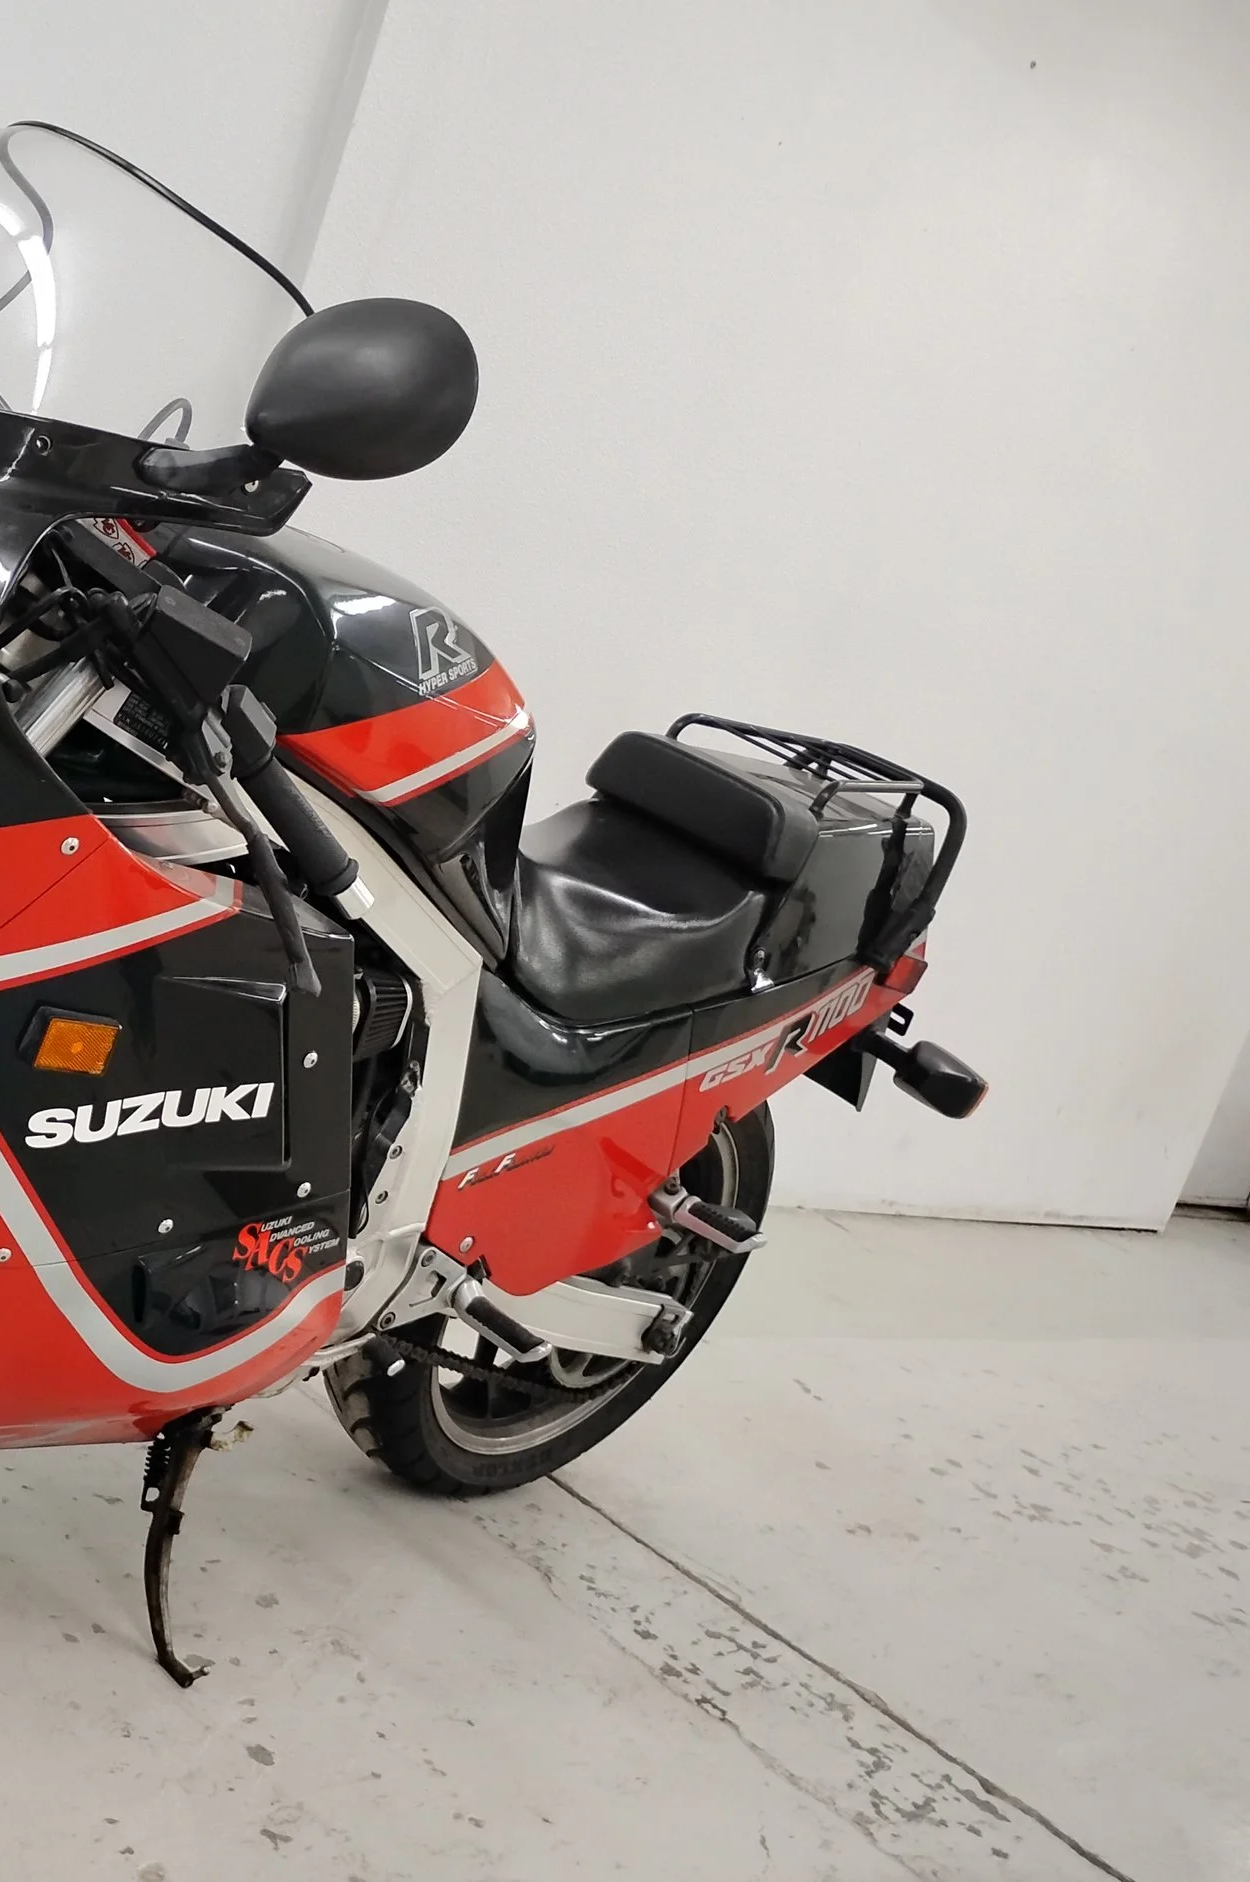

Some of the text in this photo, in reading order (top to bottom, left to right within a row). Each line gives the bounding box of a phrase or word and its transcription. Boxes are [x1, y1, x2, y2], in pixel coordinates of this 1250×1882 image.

[418, 658, 477, 696] HYPER SPORTS
[25, 1082, 274, 1149] SUZUKI
